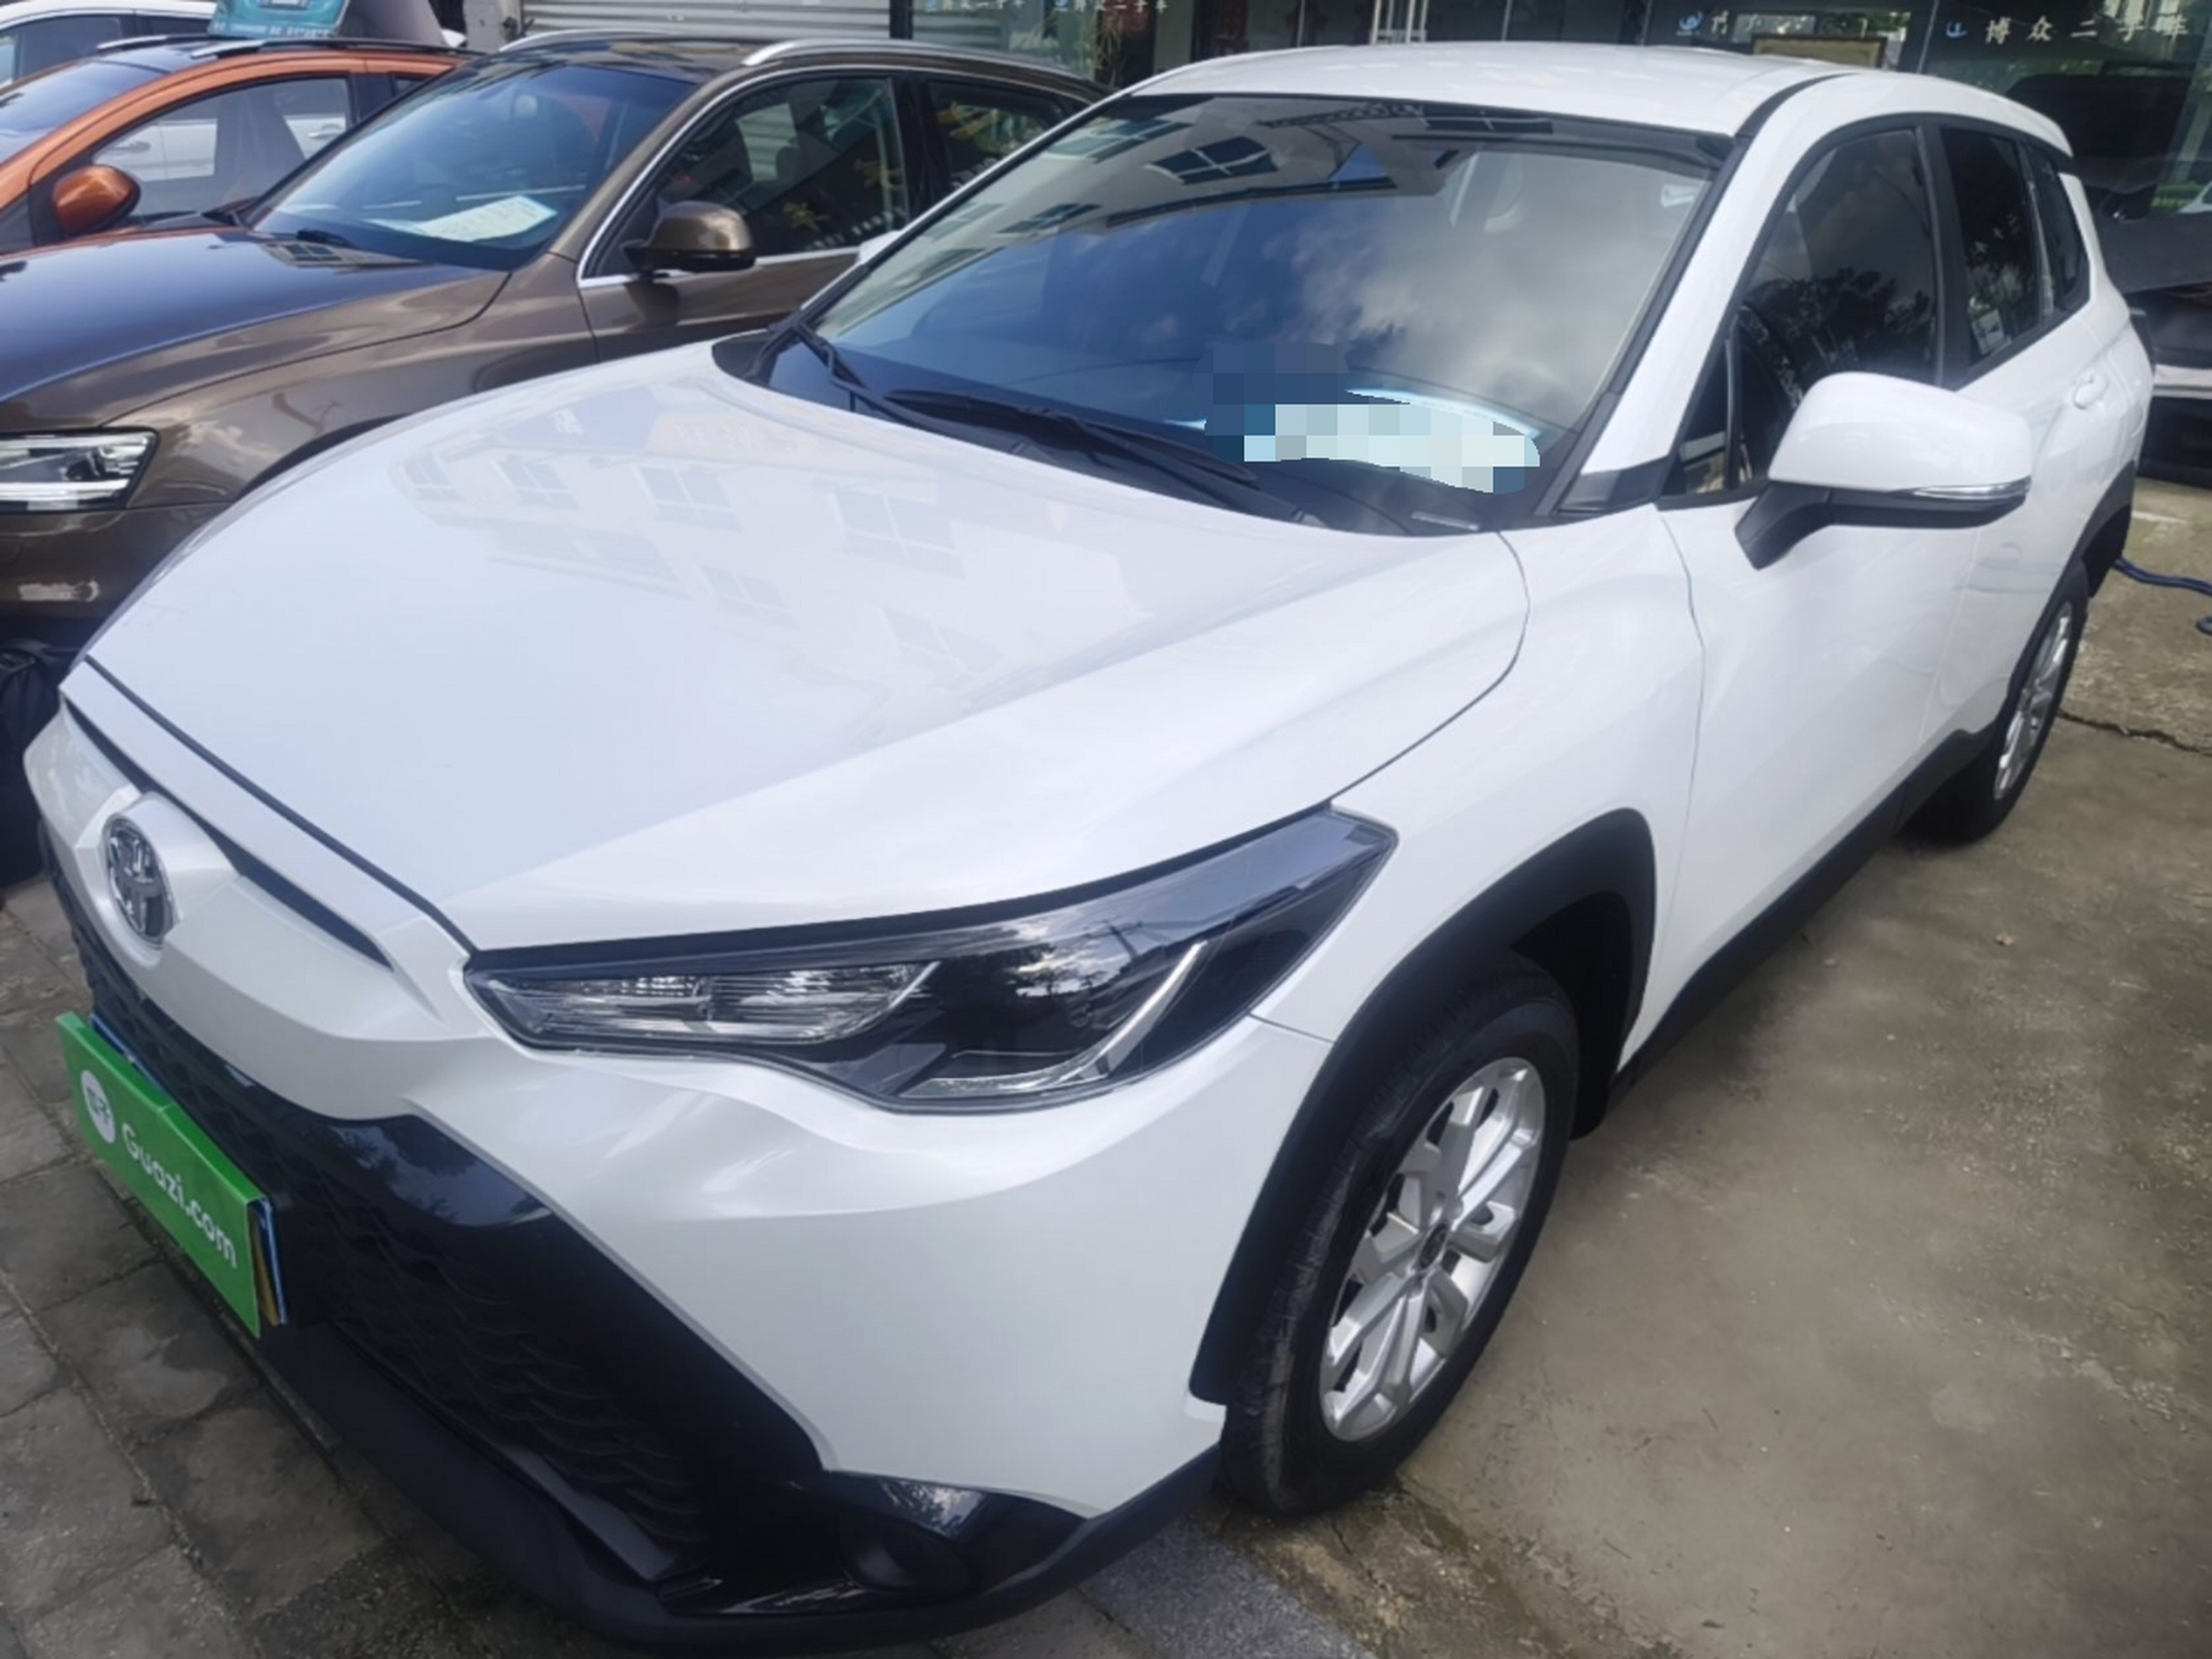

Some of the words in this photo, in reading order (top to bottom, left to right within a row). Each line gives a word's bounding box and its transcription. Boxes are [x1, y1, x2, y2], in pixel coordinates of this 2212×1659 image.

[1985, 16, 2188, 46] 博众二手车
[122, 1122, 237, 1269] Guazi.com
